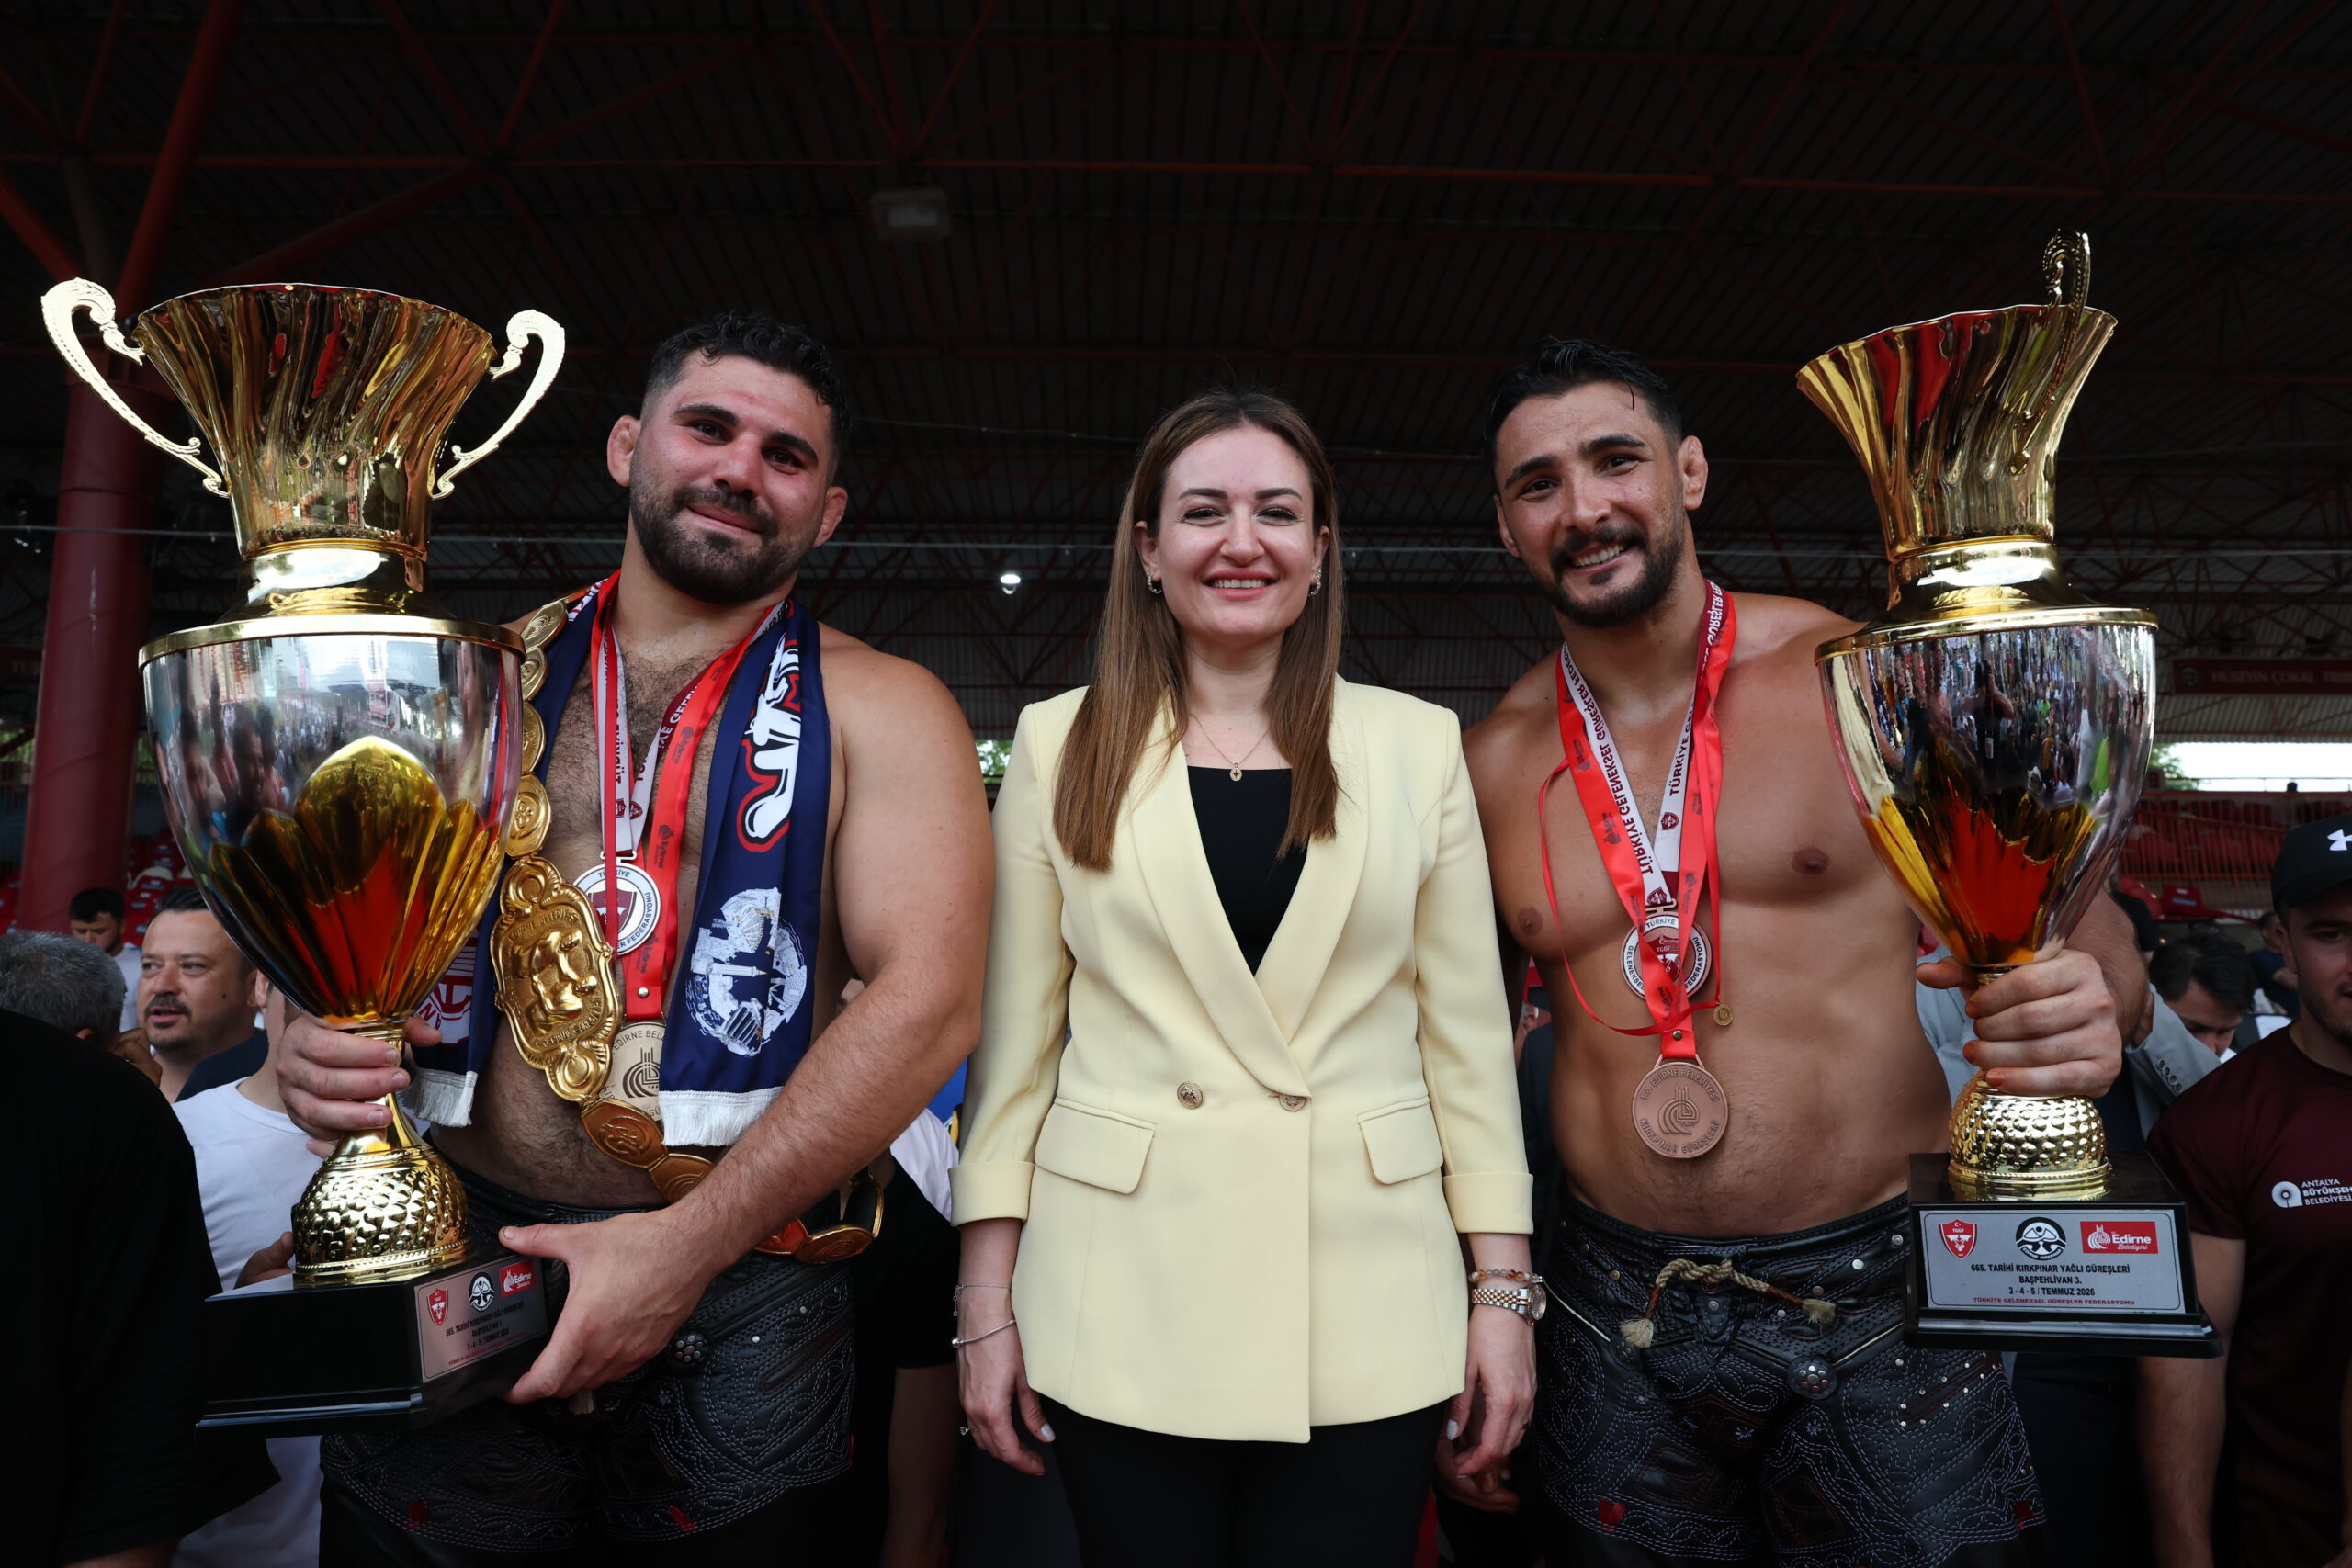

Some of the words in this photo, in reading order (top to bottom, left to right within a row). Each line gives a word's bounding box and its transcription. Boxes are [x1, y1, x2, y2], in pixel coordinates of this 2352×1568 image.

[1668, 736, 1690, 796] TÜRKİYE
[628, 892, 653, 944] FEDERASYONU
[1646, 918, 1676, 928] TÜRKİYE
[613, 1030, 643, 1051] EDİRNE
[2301, 1179, 2340, 1188] ANTALYA
[2304, 1194, 2352, 1205] BELEDİYESİ
[2111, 1234, 2152, 1244] Edirne
[1971, 1264, 1986, 1272] 665.
[1988, 1262, 2014, 1272] TARİHİ
[2016, 1264, 2058, 1273] KIRKPINAR
[2060, 1263, 2084, 1273] YAĞLI
[2086, 1263, 2131, 1275] GÜREŞLERİ
[2019, 1275, 2073, 1285] BAŞPEHLİVAN
[2075, 1276, 2082, 1284] 3.
[2041, 1287, 2075, 1295] TEMMUZ
[2076, 1288, 2096, 1296] 2026
